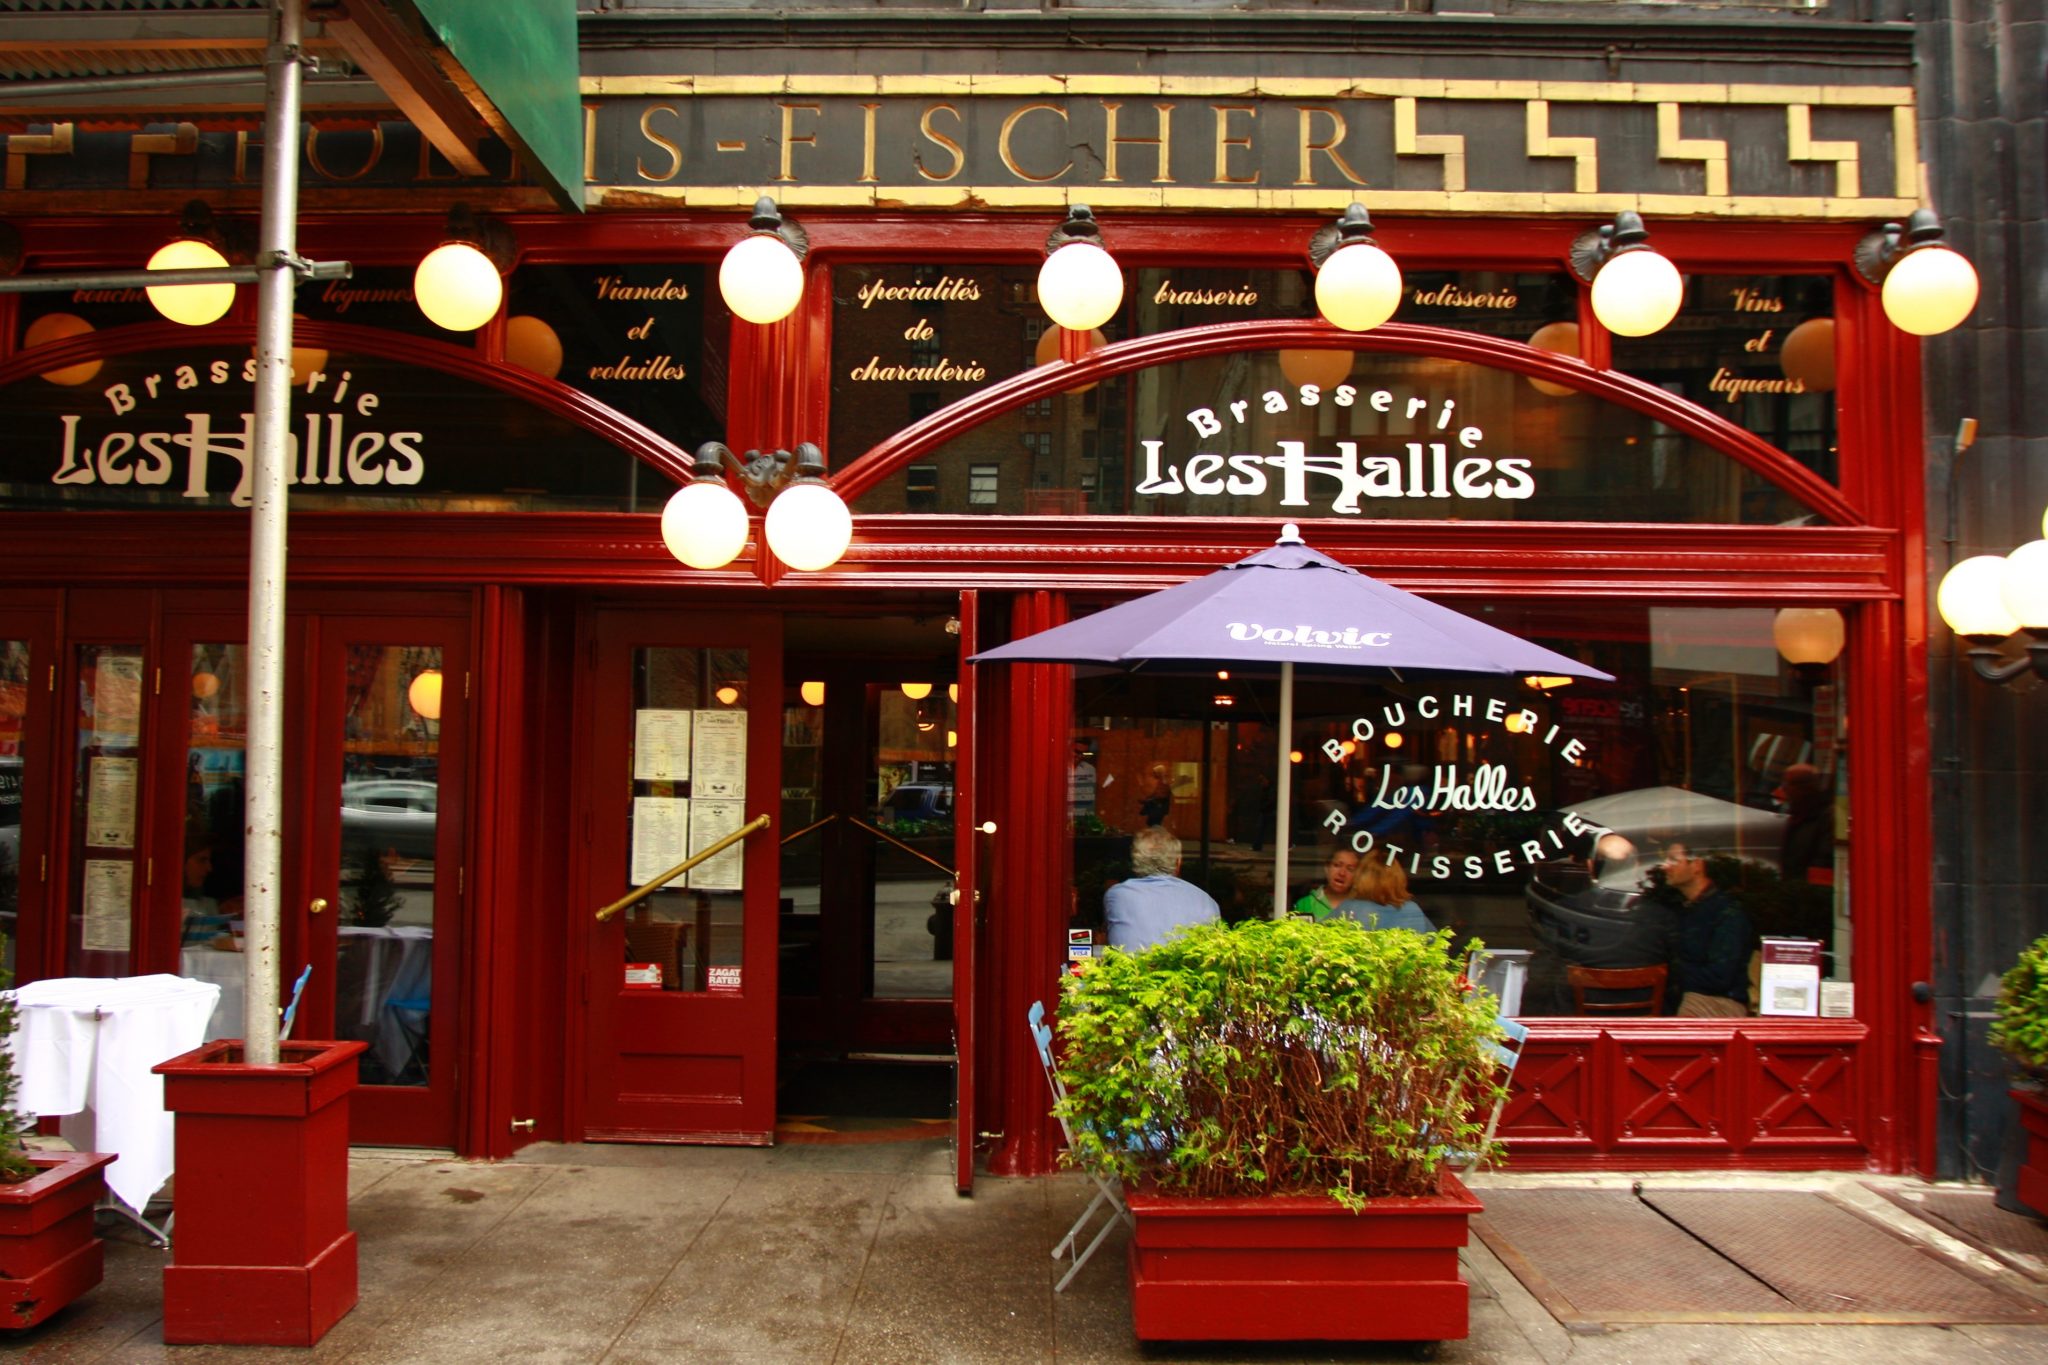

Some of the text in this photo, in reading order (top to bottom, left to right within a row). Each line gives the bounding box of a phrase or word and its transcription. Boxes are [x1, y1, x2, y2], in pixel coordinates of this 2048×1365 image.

[597, 275, 689, 301] Viandes
[857, 276, 982, 309] specialités
[1154, 280, 1258, 306] brasserie
[1414, 284, 1518, 310] rotisserie
[1731, 288, 1784, 312] Vins
[628, 317, 654, 340] et
[904, 317, 934, 342] de
[1744, 329, 1773, 352] et
[589, 356, 686, 381] volailles
[850, 356, 986, 382] charcuterie
[104, 358, 379, 417] Brassrie
[1709, 367, 1805, 403] liqueurs
[1187, 384, 1483, 449] Brasserie
[51, 415, 173, 485] Les
[1135, 440, 1536, 515] Les Halles
[1225, 622, 1393, 647] Volvic
[1322, 694, 1587, 764] BOUCHERIE
[1371, 763, 1537, 812] Les Halles
[1323, 809, 1588, 879] ROTISSERIE
[708, 967, 742, 977] ZAGAT
[708, 976, 741, 985] RATED
